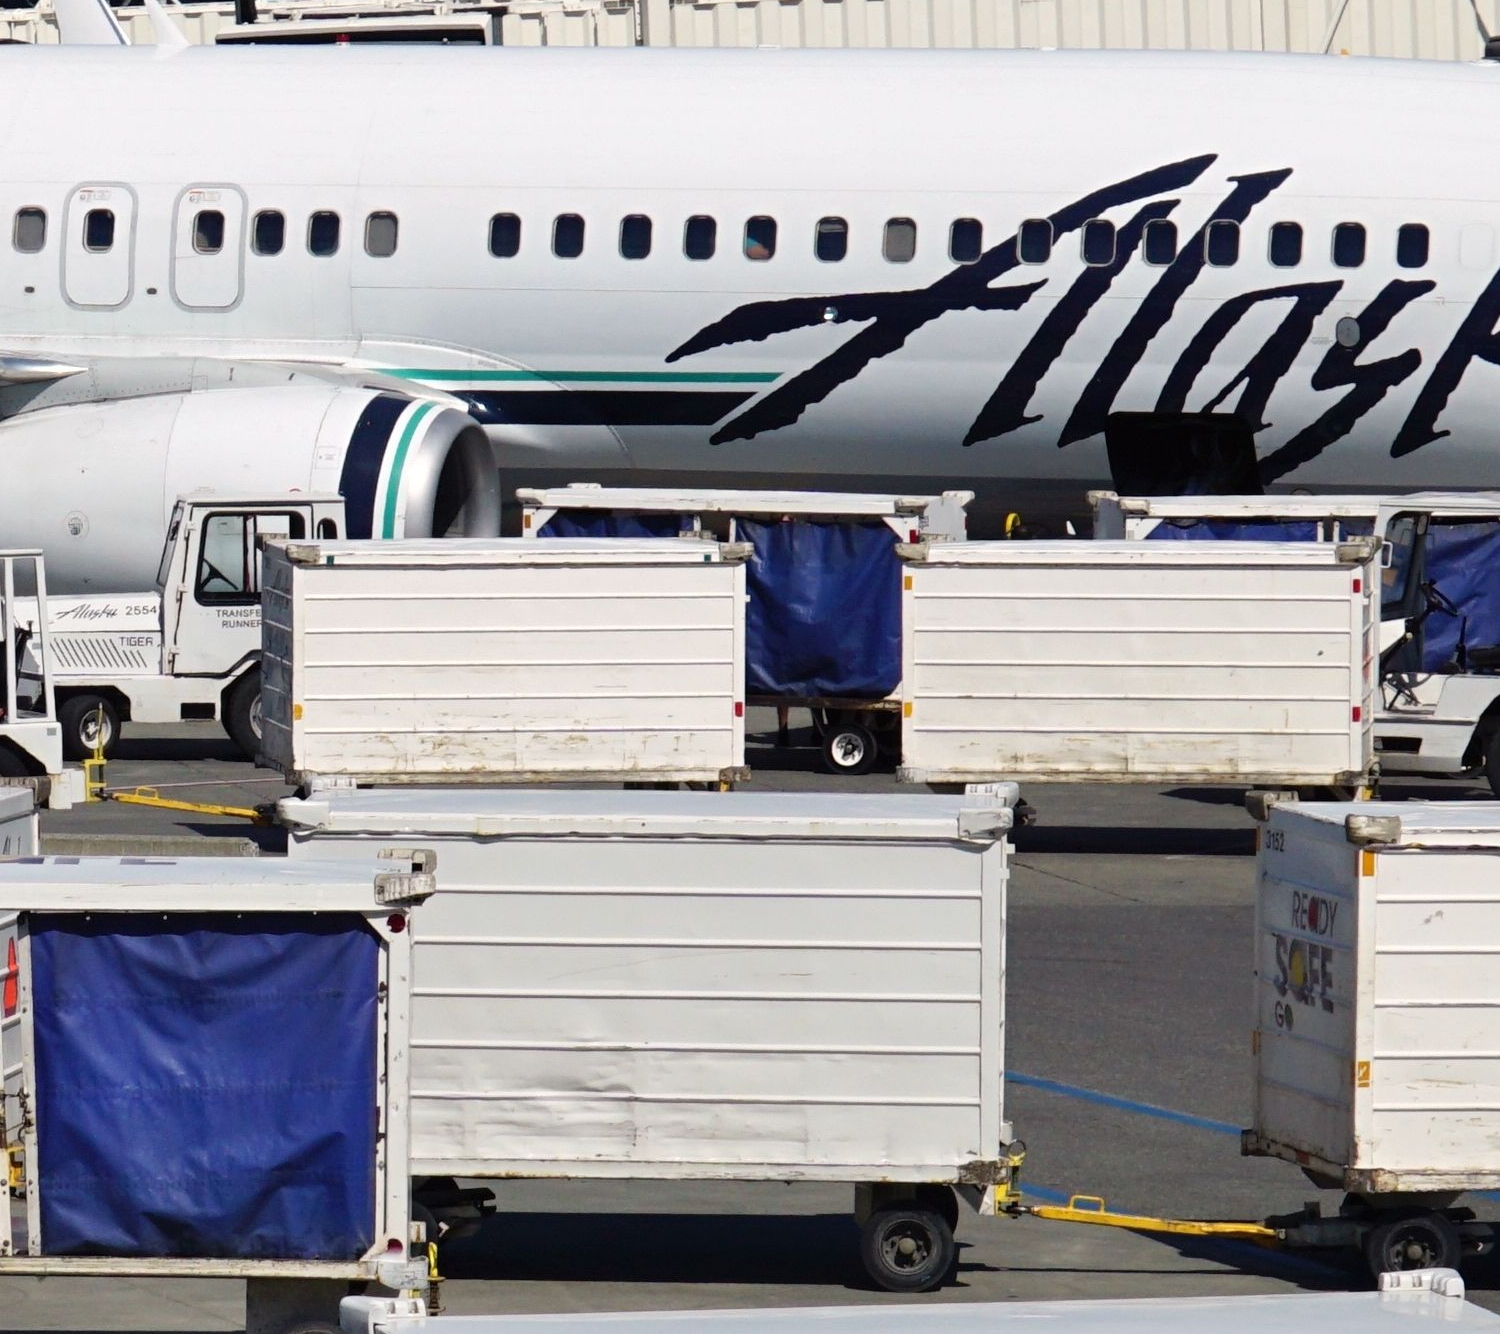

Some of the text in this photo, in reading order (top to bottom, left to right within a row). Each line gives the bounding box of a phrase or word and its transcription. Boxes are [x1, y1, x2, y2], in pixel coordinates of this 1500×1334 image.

[56, 603, 157, 622] Alaska 2554
[118, 636, 154, 647] TIGER
[1266, 829, 1286, 852] 3152
